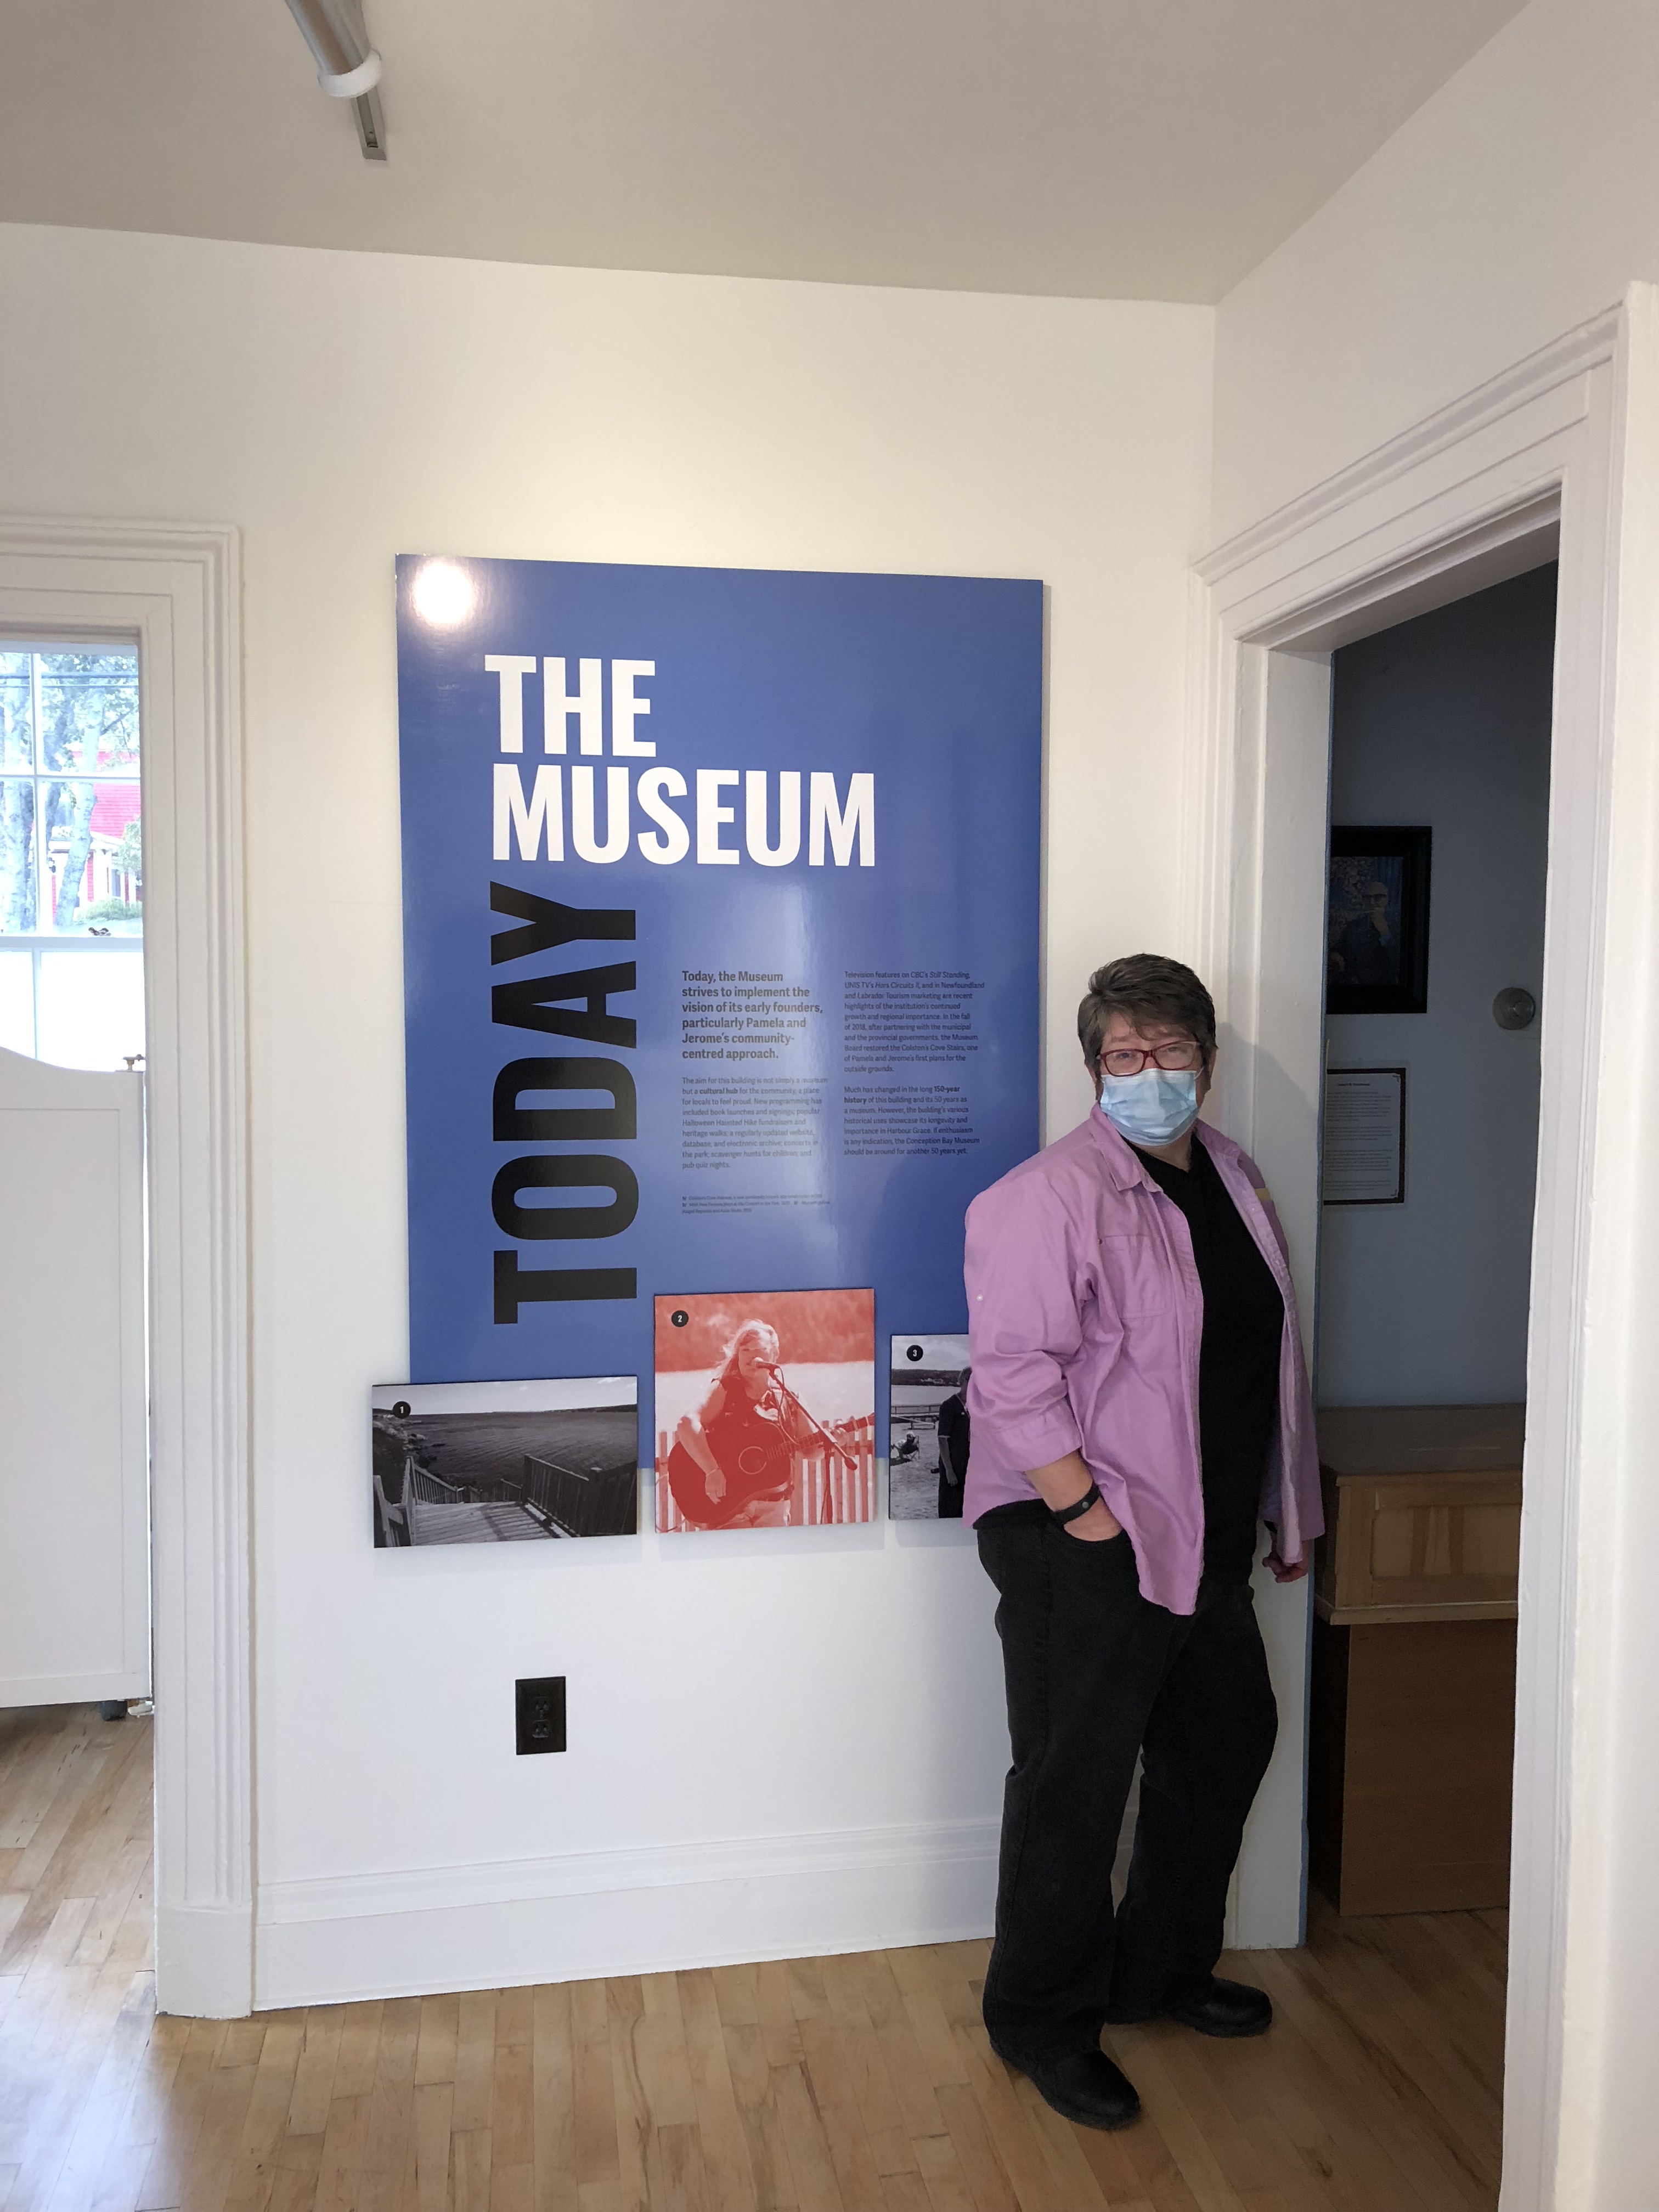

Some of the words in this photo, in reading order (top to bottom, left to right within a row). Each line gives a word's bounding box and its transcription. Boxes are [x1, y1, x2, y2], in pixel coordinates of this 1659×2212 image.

[484, 654, 657, 758] THE
[493, 763, 875, 867] MUSEUM
[682, 970, 716, 984] Today,
[719, 970, 736, 981] the
[738, 970, 783, 981] Museum
[682, 987, 718, 997] strives
[721, 987, 732, 997] to
[735, 987, 789, 999] implement
[792, 987, 809, 997] the
[682, 1002, 713, 1012] vision
[716, 1002, 727, 1012] of
[729, 1002, 742, 1012] its
[745, 1002, 771, 1015] early
[774, 1002, 822, 1013] founders,
[682, 1017, 744, 1030] particularly
[747, 1017, 784, 1028] Pamela
[787, 1017, 806, 1028] and
[682, 1032, 729, 1043] Jerome's
[732, 1032, 794, 1046] community-
[682, 1048, 723, 1058] centred
[726, 1048, 778, 1061] approach.
[919, 1085, 933, 1093] long
[490, 881, 639, 1324] TODAY
[400, 1406, 404, 1414] 1
